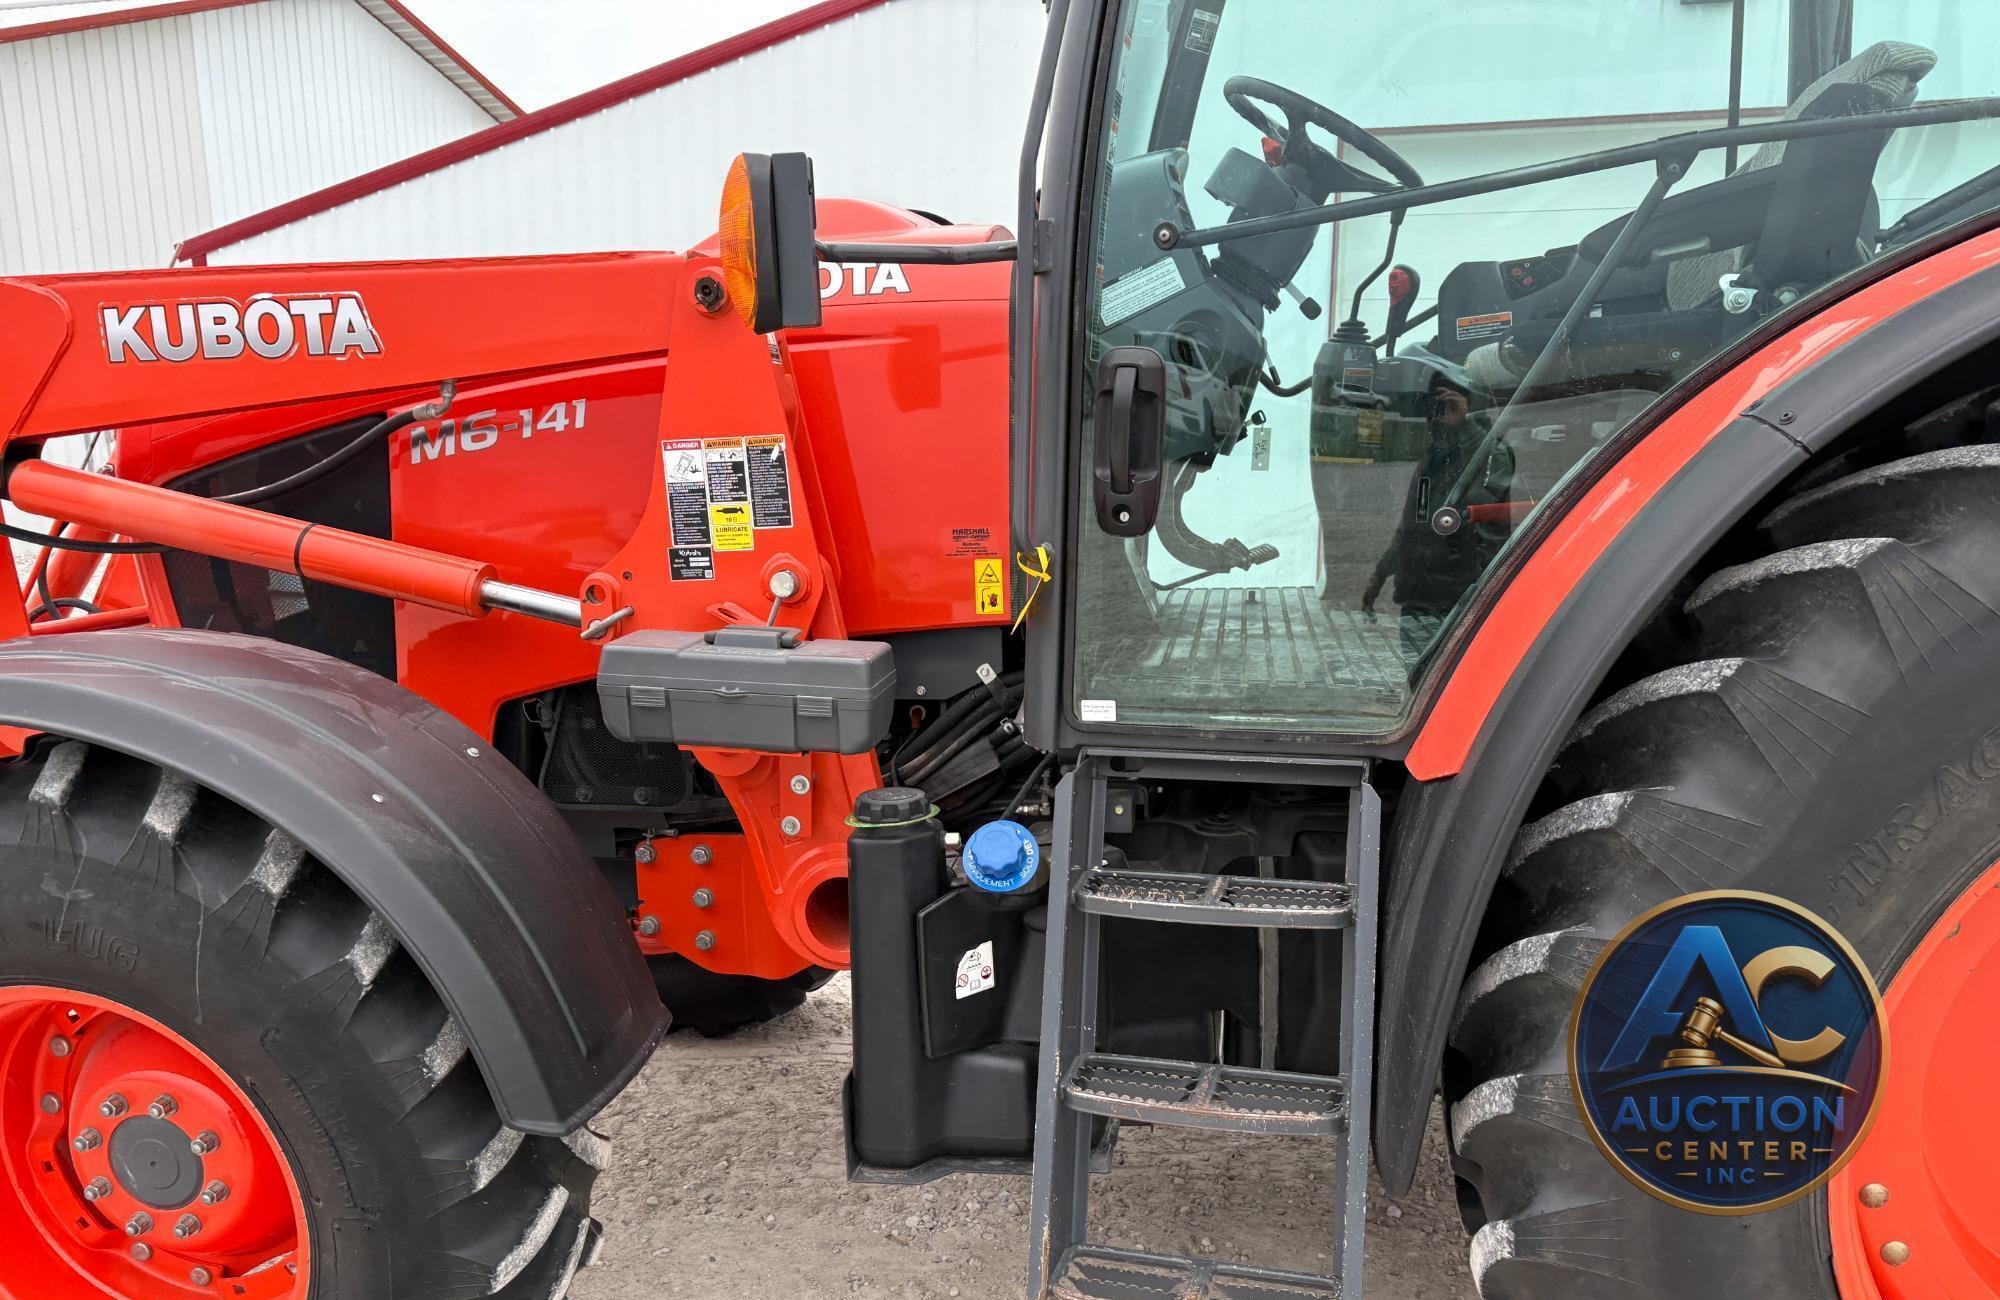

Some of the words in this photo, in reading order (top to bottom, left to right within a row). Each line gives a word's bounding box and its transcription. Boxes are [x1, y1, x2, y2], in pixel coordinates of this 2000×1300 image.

[102, 296, 382, 363] KUBOTA
[410, 397, 587, 464] M6-141
[711, 439, 741, 447] WARNING
[753, 437, 782, 445] WARNING
[715, 526, 749, 534] LUBRICATE
[952, 528, 990, 536] MARSHALL
[678, 549, 702, 557] Kubota
[968, 861, 1015, 888] UNIQUEMENT
[1019, 857, 1034, 878] SOLO
[43, 912, 141, 974] LUG
